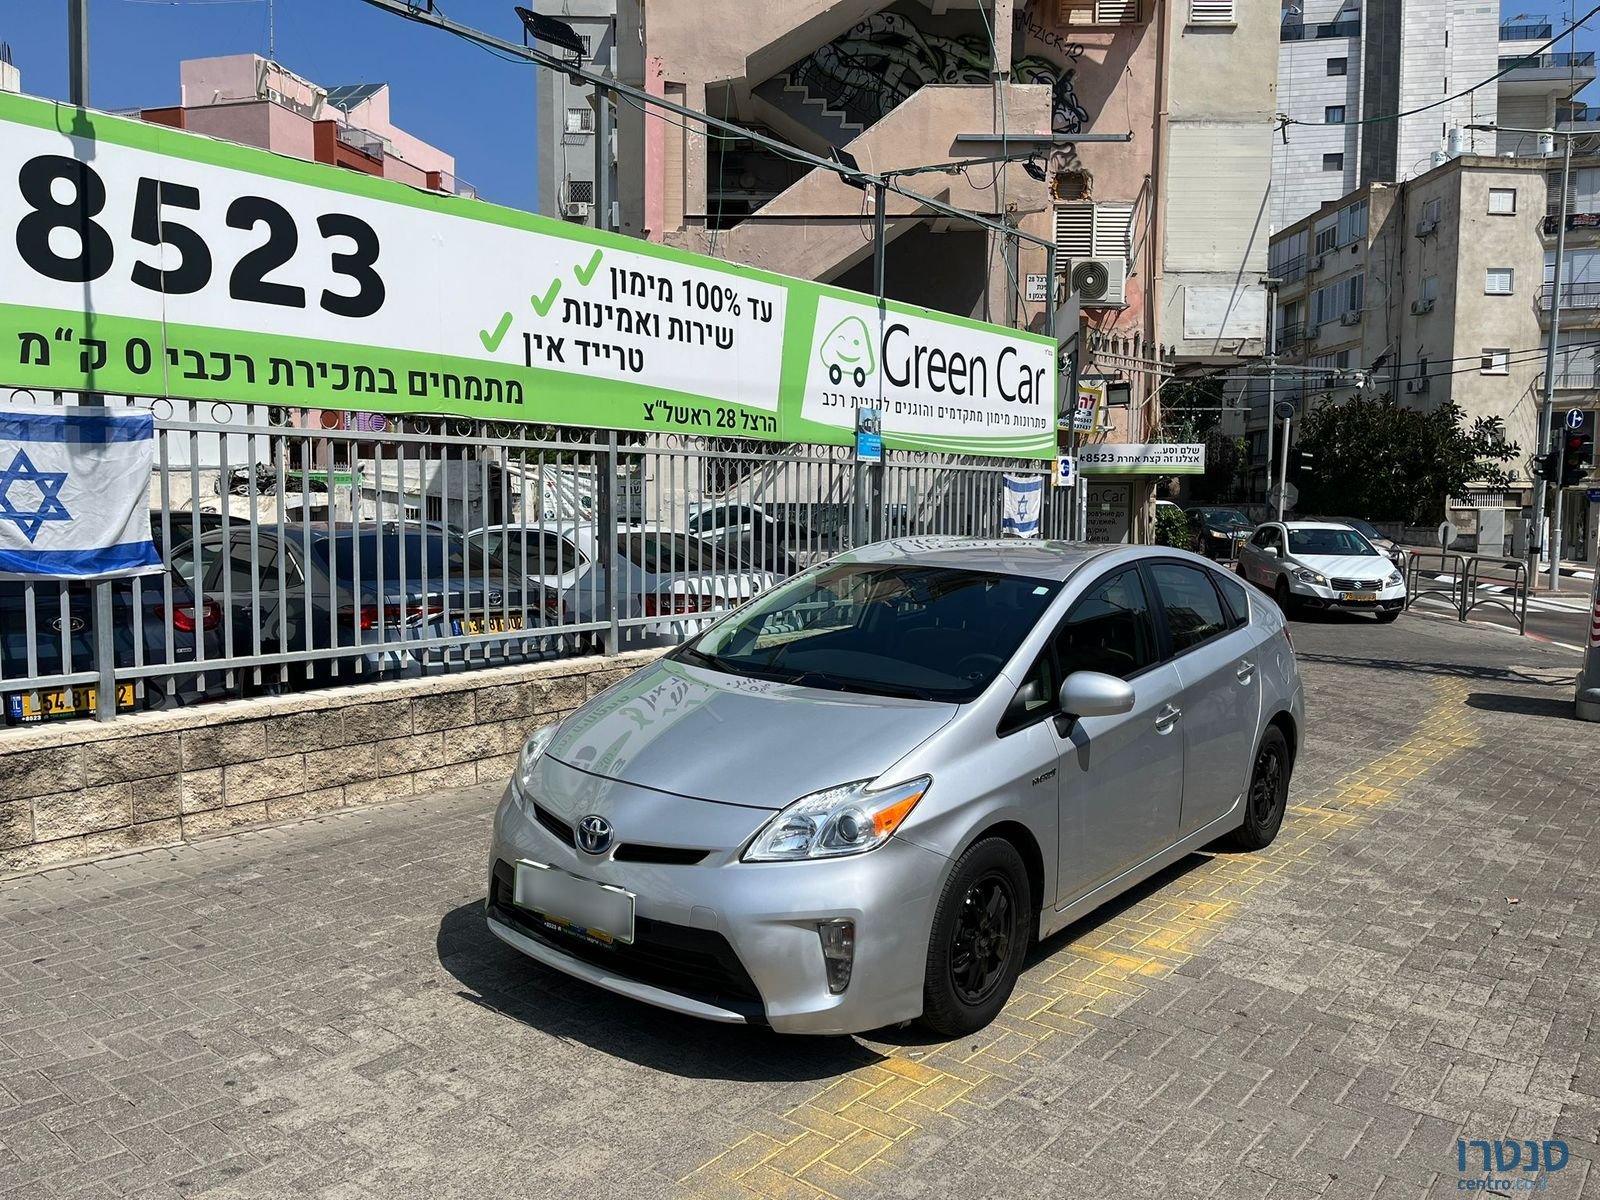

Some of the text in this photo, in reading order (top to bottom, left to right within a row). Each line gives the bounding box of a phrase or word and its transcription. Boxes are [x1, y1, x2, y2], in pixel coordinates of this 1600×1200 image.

[15, 154, 386, 317] 8523
[609, 267, 773, 323] עד 100% מימון
[562, 298, 734, 350] שירות ואמינות
[125, 337, 151, 374] 0
[523, 331, 644, 373] טרייד אין
[165, 346, 256, 385] רכבי
[269, 354, 397, 395] במכירת
[882, 323, 1046, 406] Green Car
[407, 369, 524, 405] מתמחים
[822, 392, 846, 408] רכב
[895, 400, 934, 418] והוגנים
[716, 407, 736, 429] 28
[740, 409, 777, 433] הרצל
[938, 406, 983, 424] מתקדמים
[986, 410, 1010, 426] מימון
[1013, 414, 1047, 429] פתרונות
[1117, 455, 1141, 463] אחרת
[1142, 455, 1161, 464] קצת
[1163, 455, 1173, 463] זה
[1175, 455, 1200, 463] אצלנו
[1180, 446, 1200, 454] שלם
